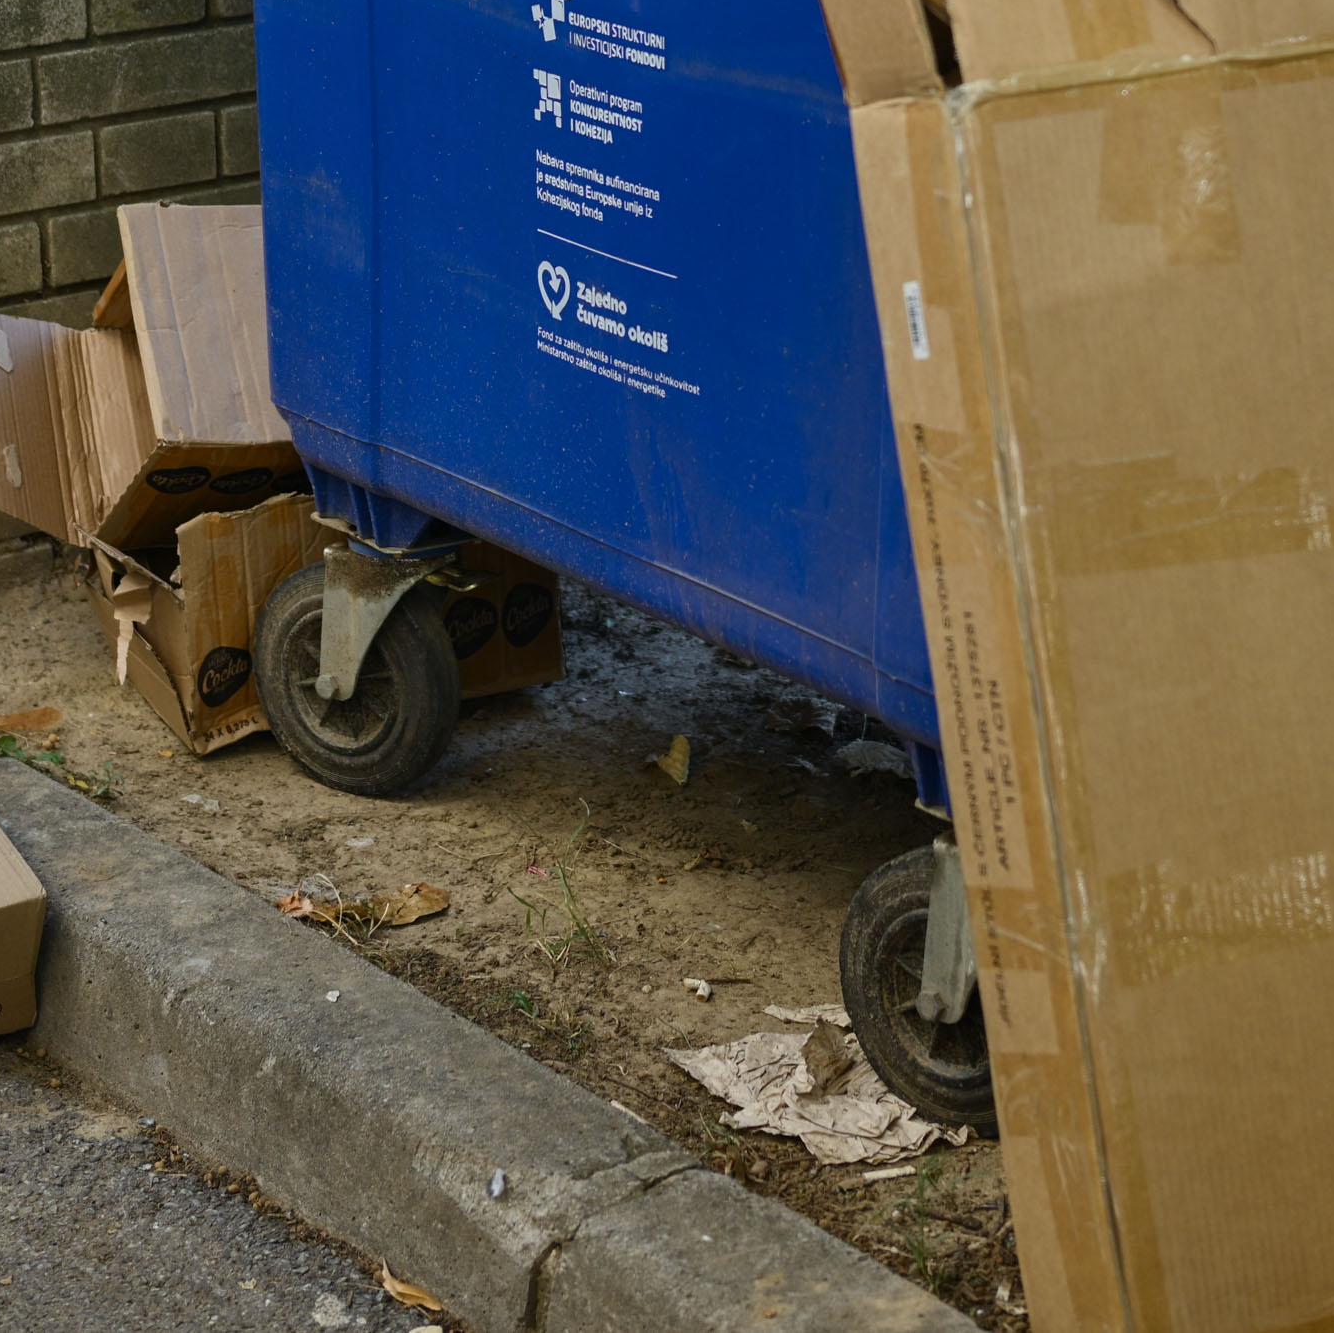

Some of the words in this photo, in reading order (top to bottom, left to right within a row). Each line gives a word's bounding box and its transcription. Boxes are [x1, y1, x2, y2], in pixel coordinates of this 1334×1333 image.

[568, 11, 611, 36] EUROPSKI
[612, 23, 665, 50] STRUKTURNI
[573, 33, 625, 59] INVESTICIJSKI
[625, 47, 665, 70] FONDOVI
[569, 79, 608, 103] Operativni
[609, 94, 643, 115] program
[570, 99, 643, 133] KONKURENTNOST
[575, 121, 613, 144] KOHEZIJA
[536, 149, 564, 171] Nabava
[565, 162, 604, 185] spremnika
[605, 174, 660, 201] sufinancirana
[536, 188, 580, 216] Kohezijskog
[581, 203, 604, 221] fonda
[544, 173, 584, 196] sredstvima
[585, 185, 622, 209] Europske
[624, 198, 644, 217] unije
[577, 281, 627, 315] Zajedno
[577, 304, 626, 337] čuvamo
[628, 325, 669, 353] okoliš
[537, 326, 554, 342] Fond
[563, 333, 584, 354] zaštitu
[585, 343, 609, 363] okoliša
[614, 357, 652, 379] energetsku
[654, 368, 700, 395] učinkovitost
[537, 340, 574, 363] Ministarstvo
[575, 352, 597, 373] zaštite
[598, 362, 622, 383] okoliša
[627, 375, 666, 398] energetike
[202, 657, 247, 694] Cockta
